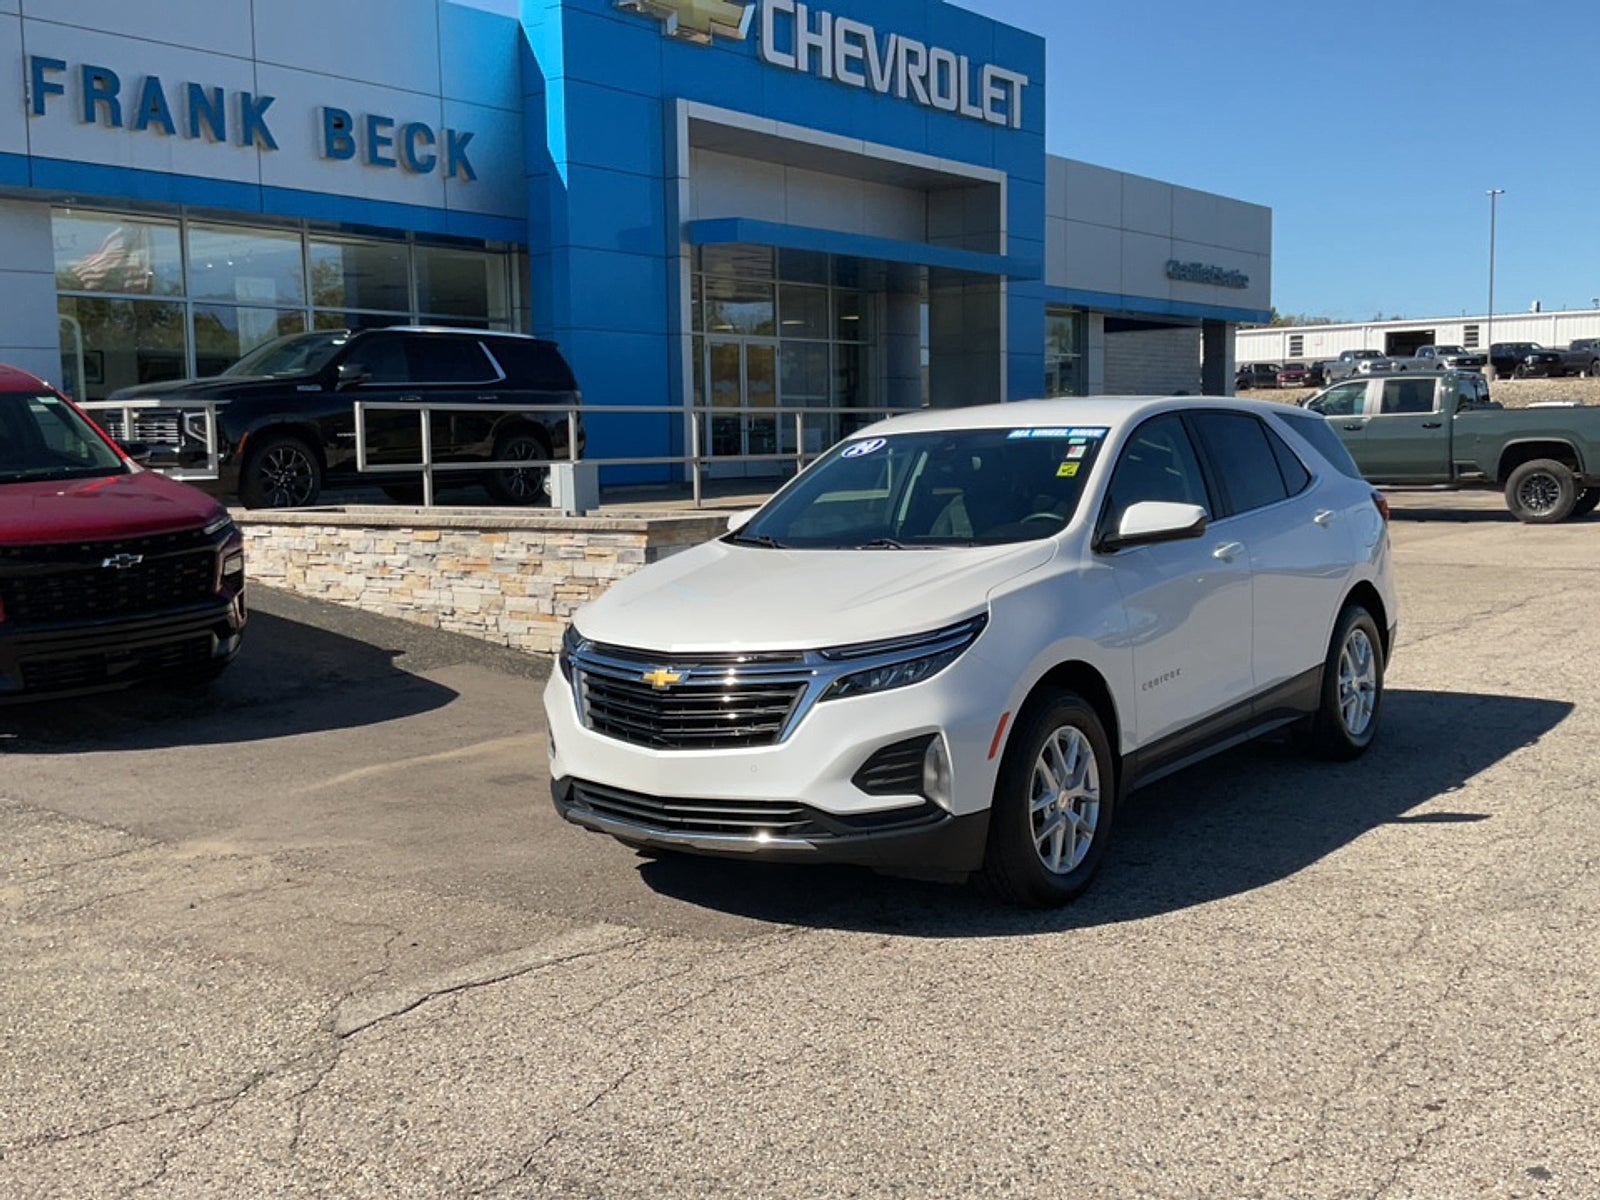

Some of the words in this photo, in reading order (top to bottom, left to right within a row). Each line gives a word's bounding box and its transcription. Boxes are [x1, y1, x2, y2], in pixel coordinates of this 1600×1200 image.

[29, 55, 279, 151] FRANK
[318, 106, 478, 182] BECK
[759, 0, 1028, 129] CHEVROLET
